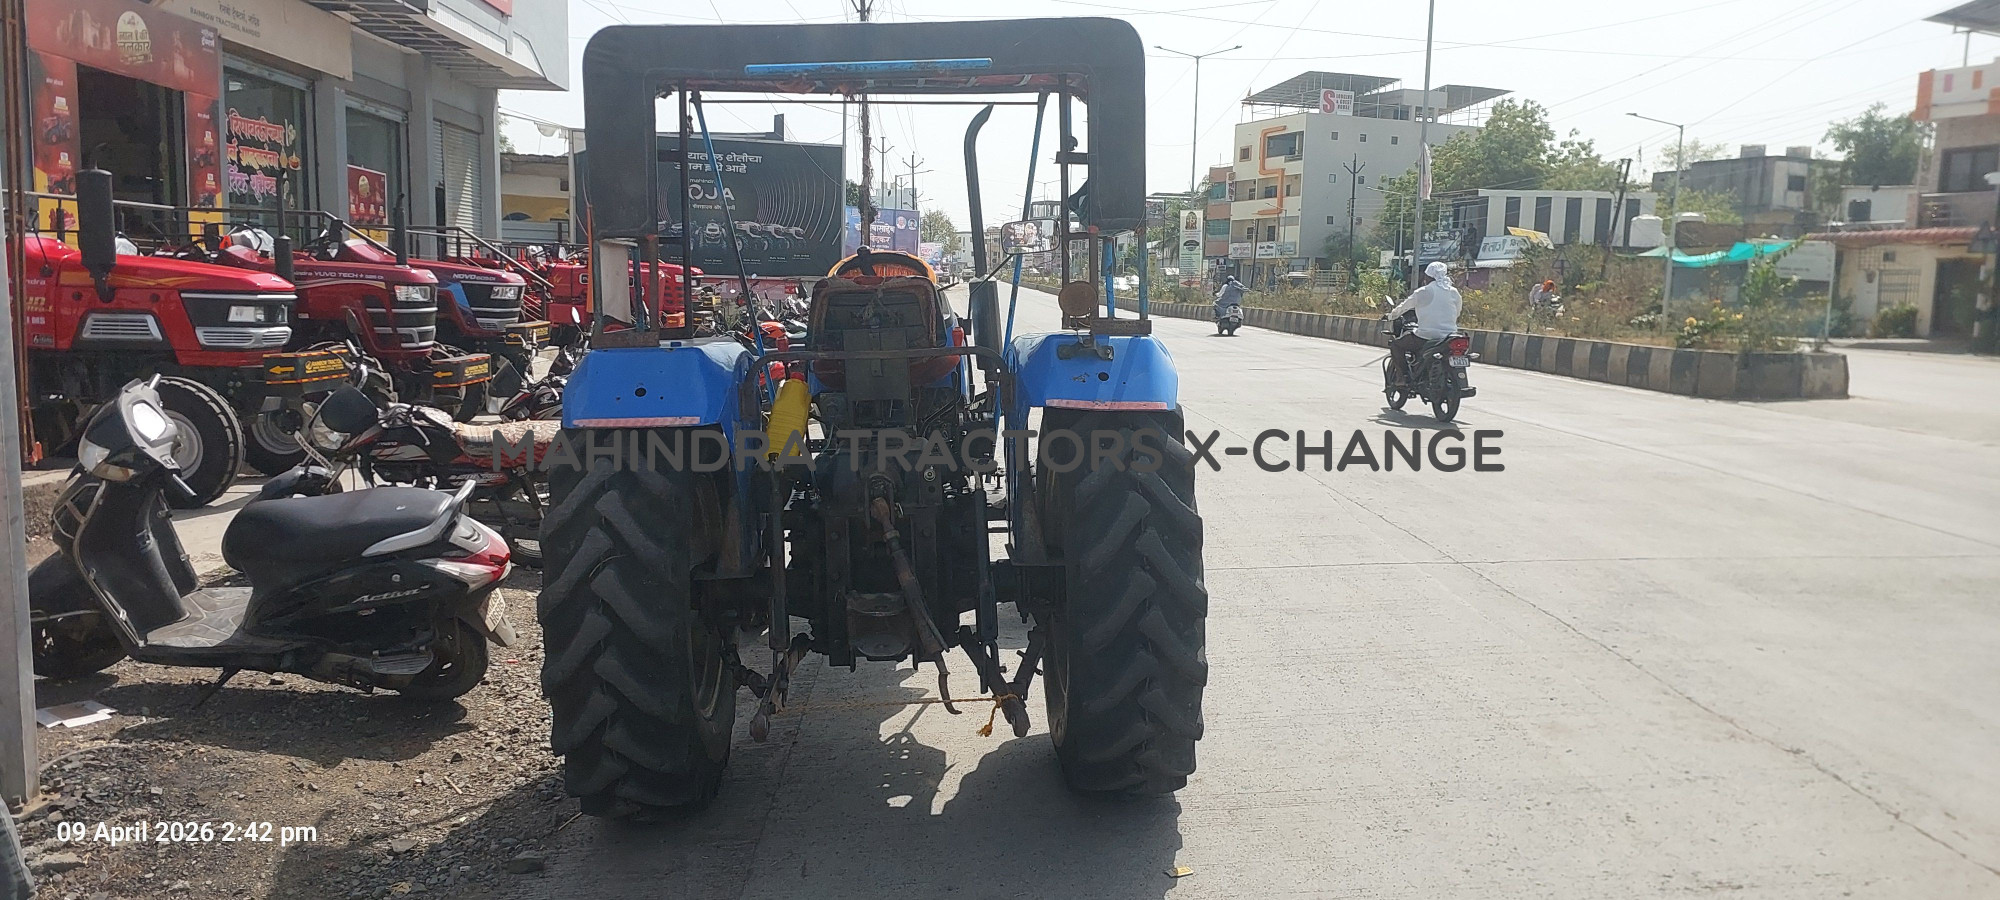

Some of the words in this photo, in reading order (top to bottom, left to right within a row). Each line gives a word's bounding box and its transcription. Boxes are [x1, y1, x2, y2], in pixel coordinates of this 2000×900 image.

[1323, 90, 1335, 113] S
[725, 152, 762, 163] शेतीचा
[725, 163, 747, 174] आहे
[227, 163, 249, 195] र्दिक
